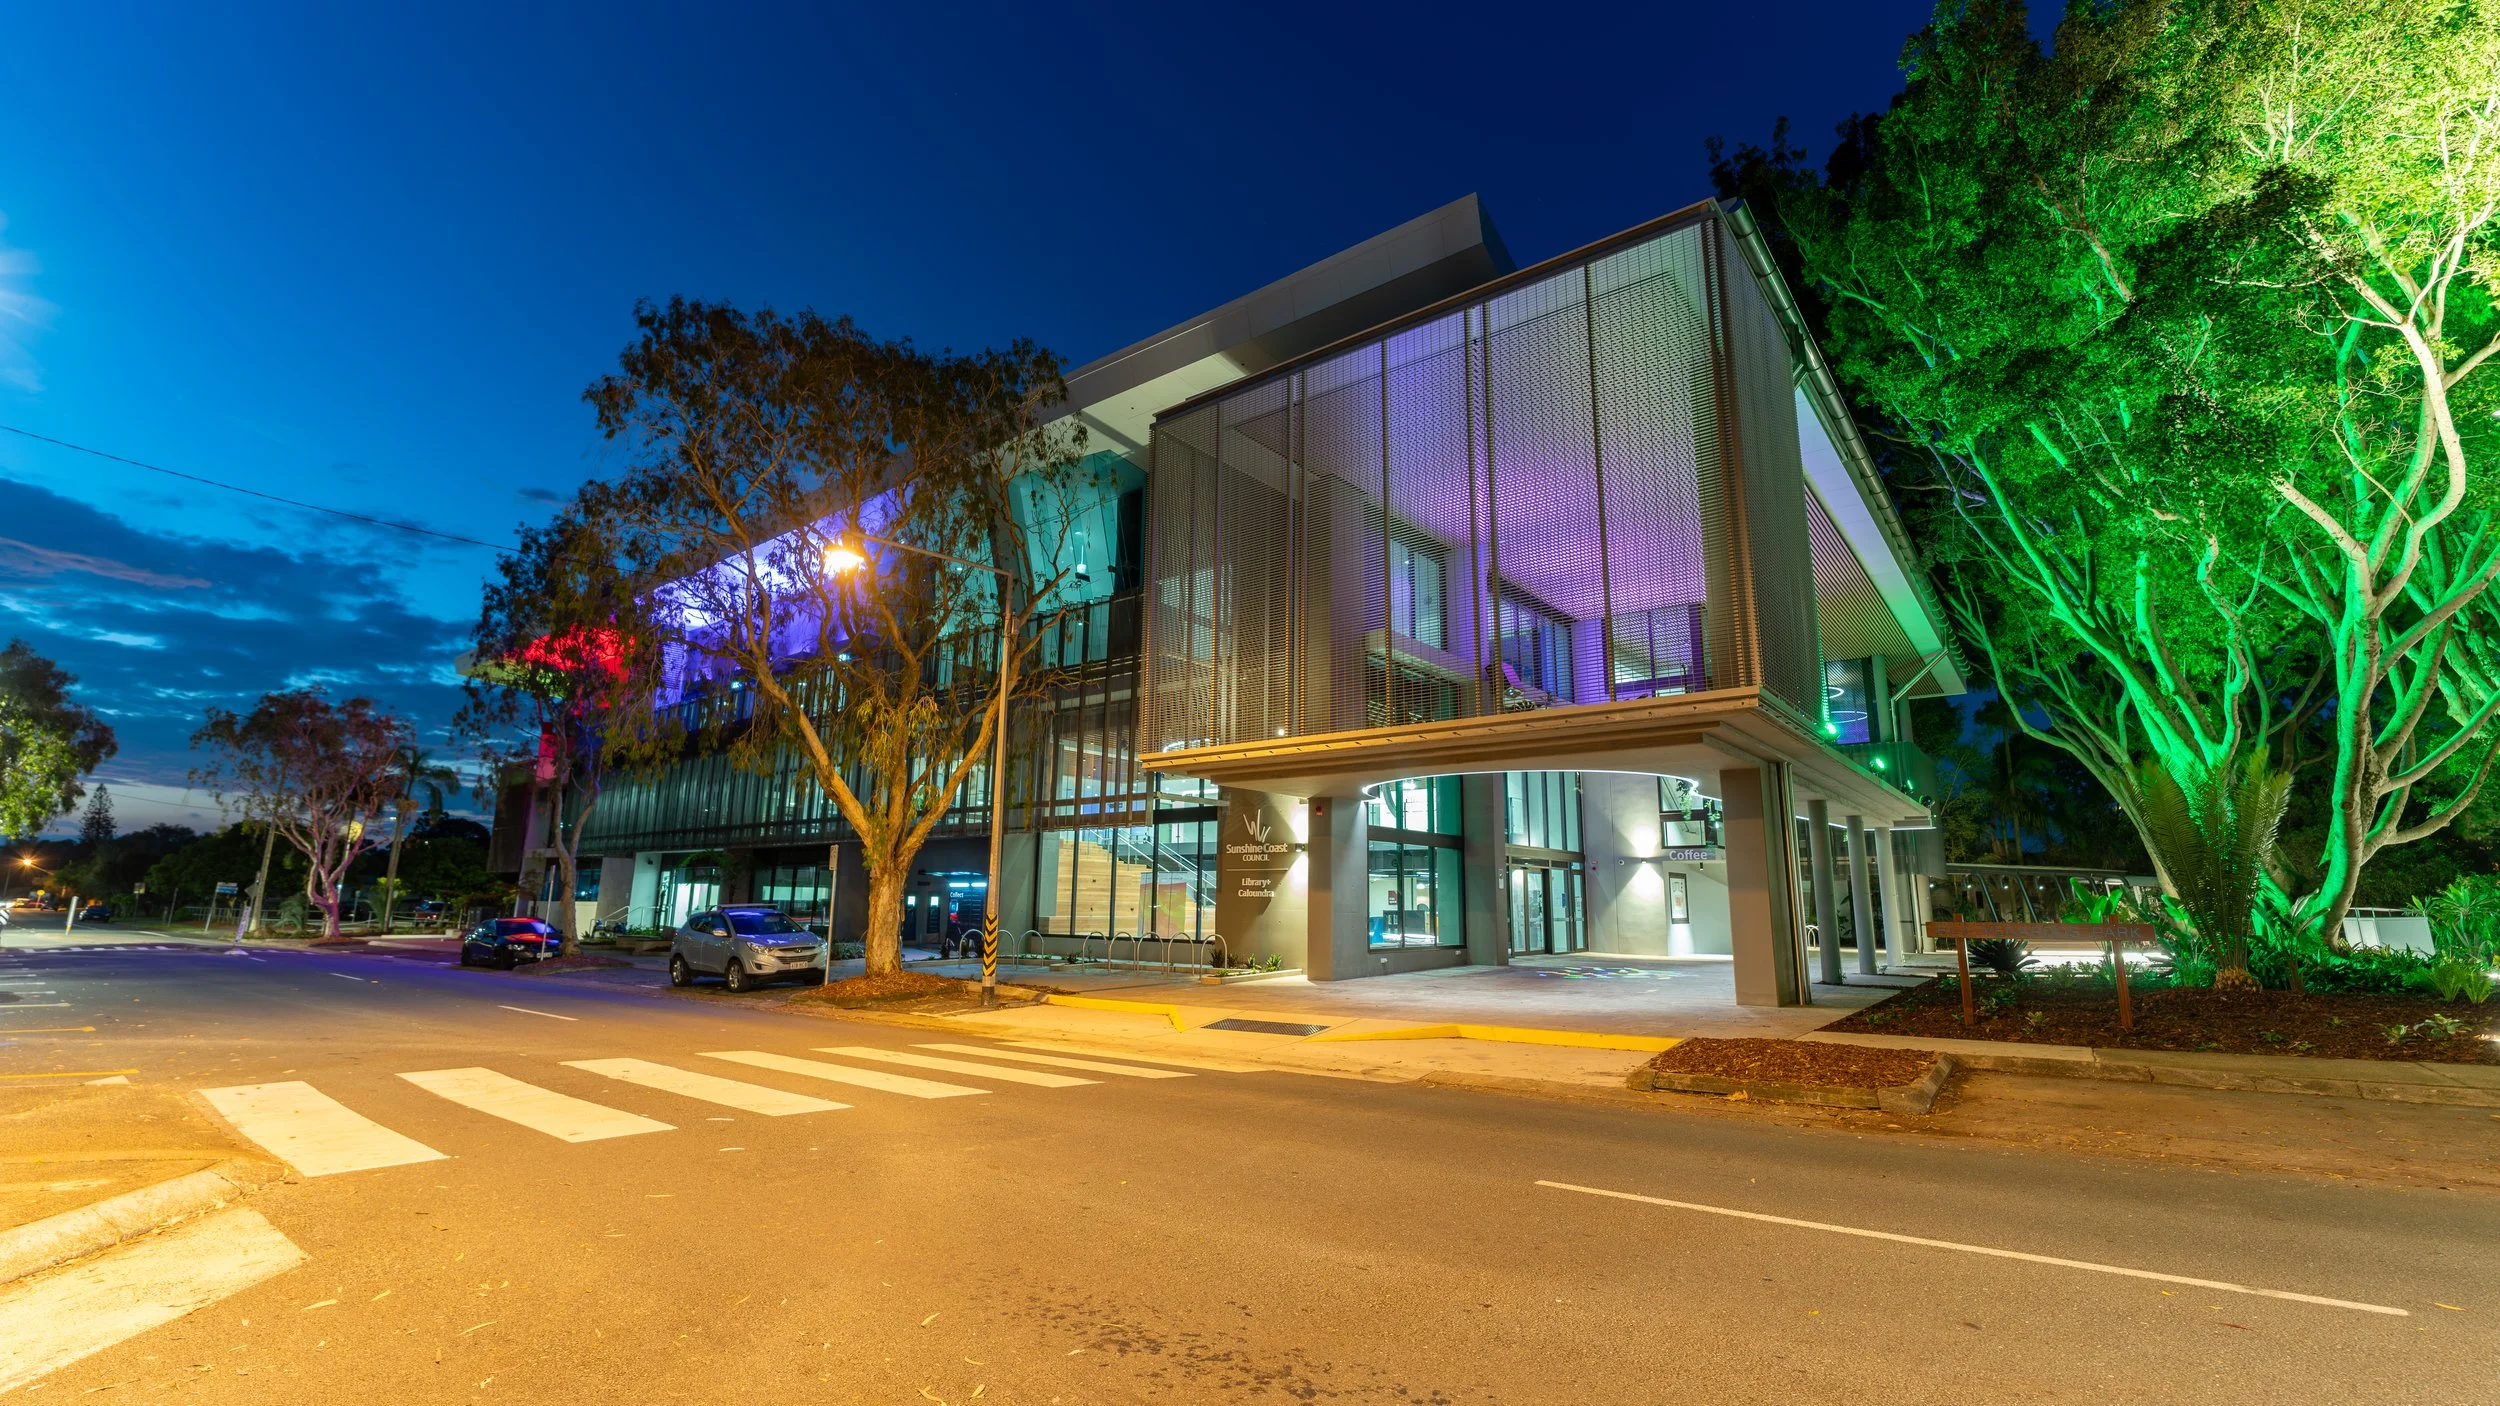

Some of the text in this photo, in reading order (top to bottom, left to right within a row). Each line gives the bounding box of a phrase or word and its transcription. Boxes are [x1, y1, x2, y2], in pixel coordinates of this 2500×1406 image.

[1226, 842, 1288, 854] Sunshine Coast
[1242, 854, 1270, 862] COUNCIL
[1669, 849, 1708, 861] Coffee
[1238, 889, 1275, 897] Caloundra
[2092, 925, 2141, 938] PARK
